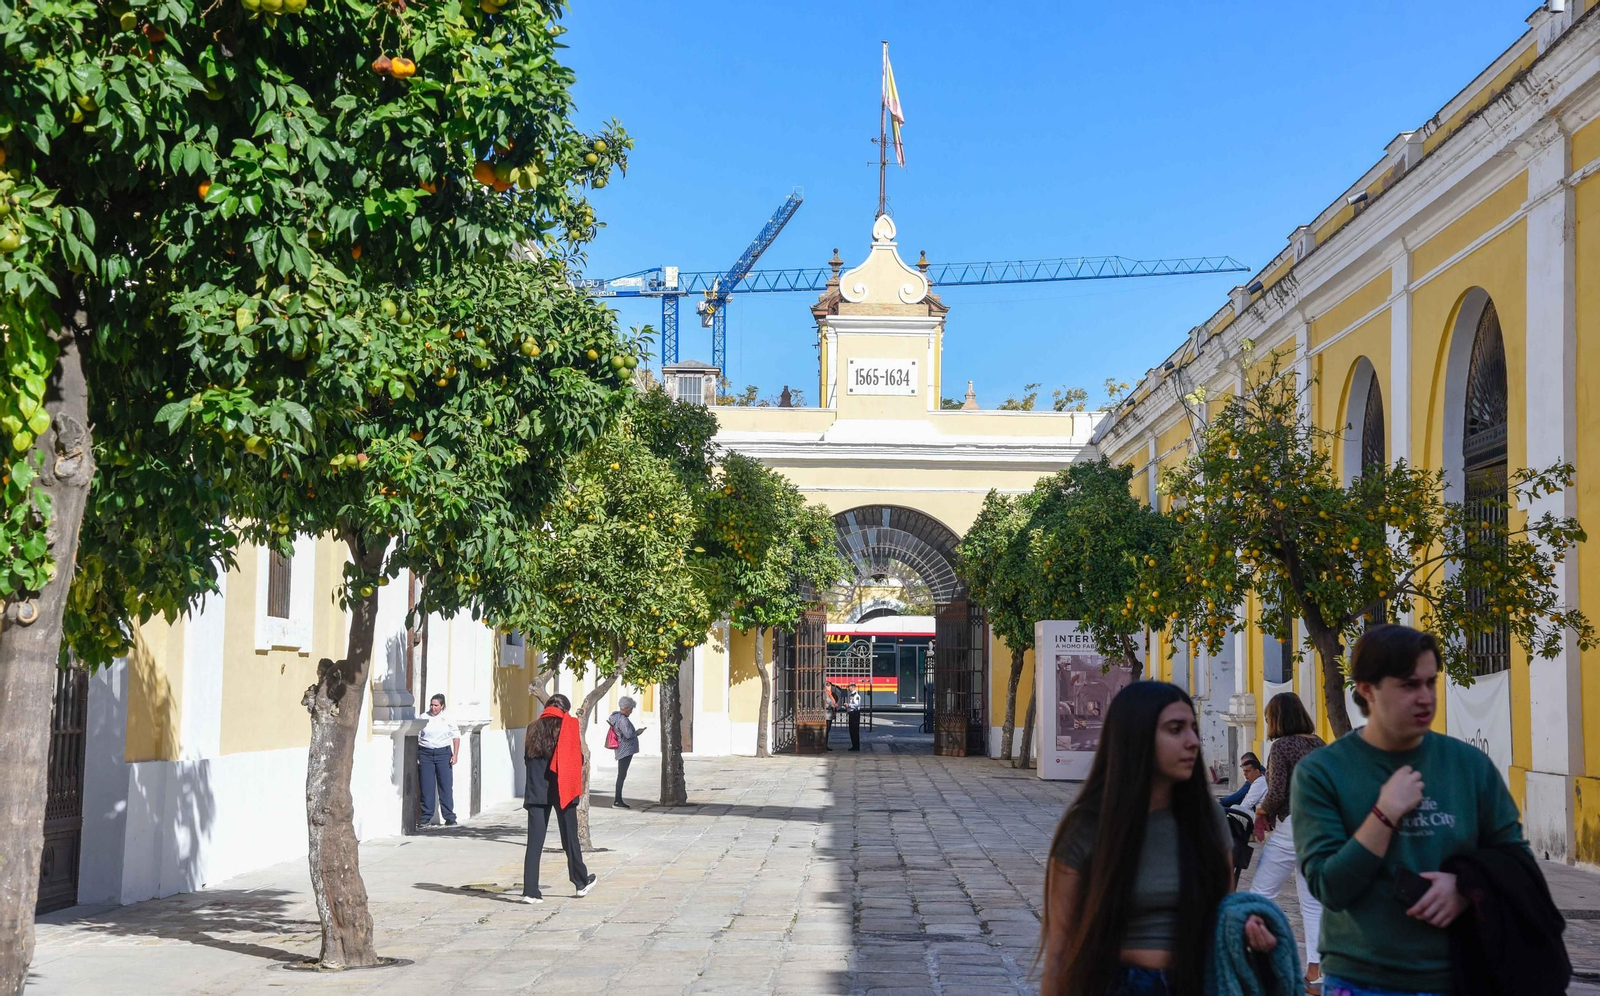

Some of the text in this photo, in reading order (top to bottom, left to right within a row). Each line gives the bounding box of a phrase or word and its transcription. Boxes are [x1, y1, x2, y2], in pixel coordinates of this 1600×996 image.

[855, 368, 910, 386] 1565-1634
[826, 634, 850, 643] ILLA
[1430, 812, 1456, 828] City
